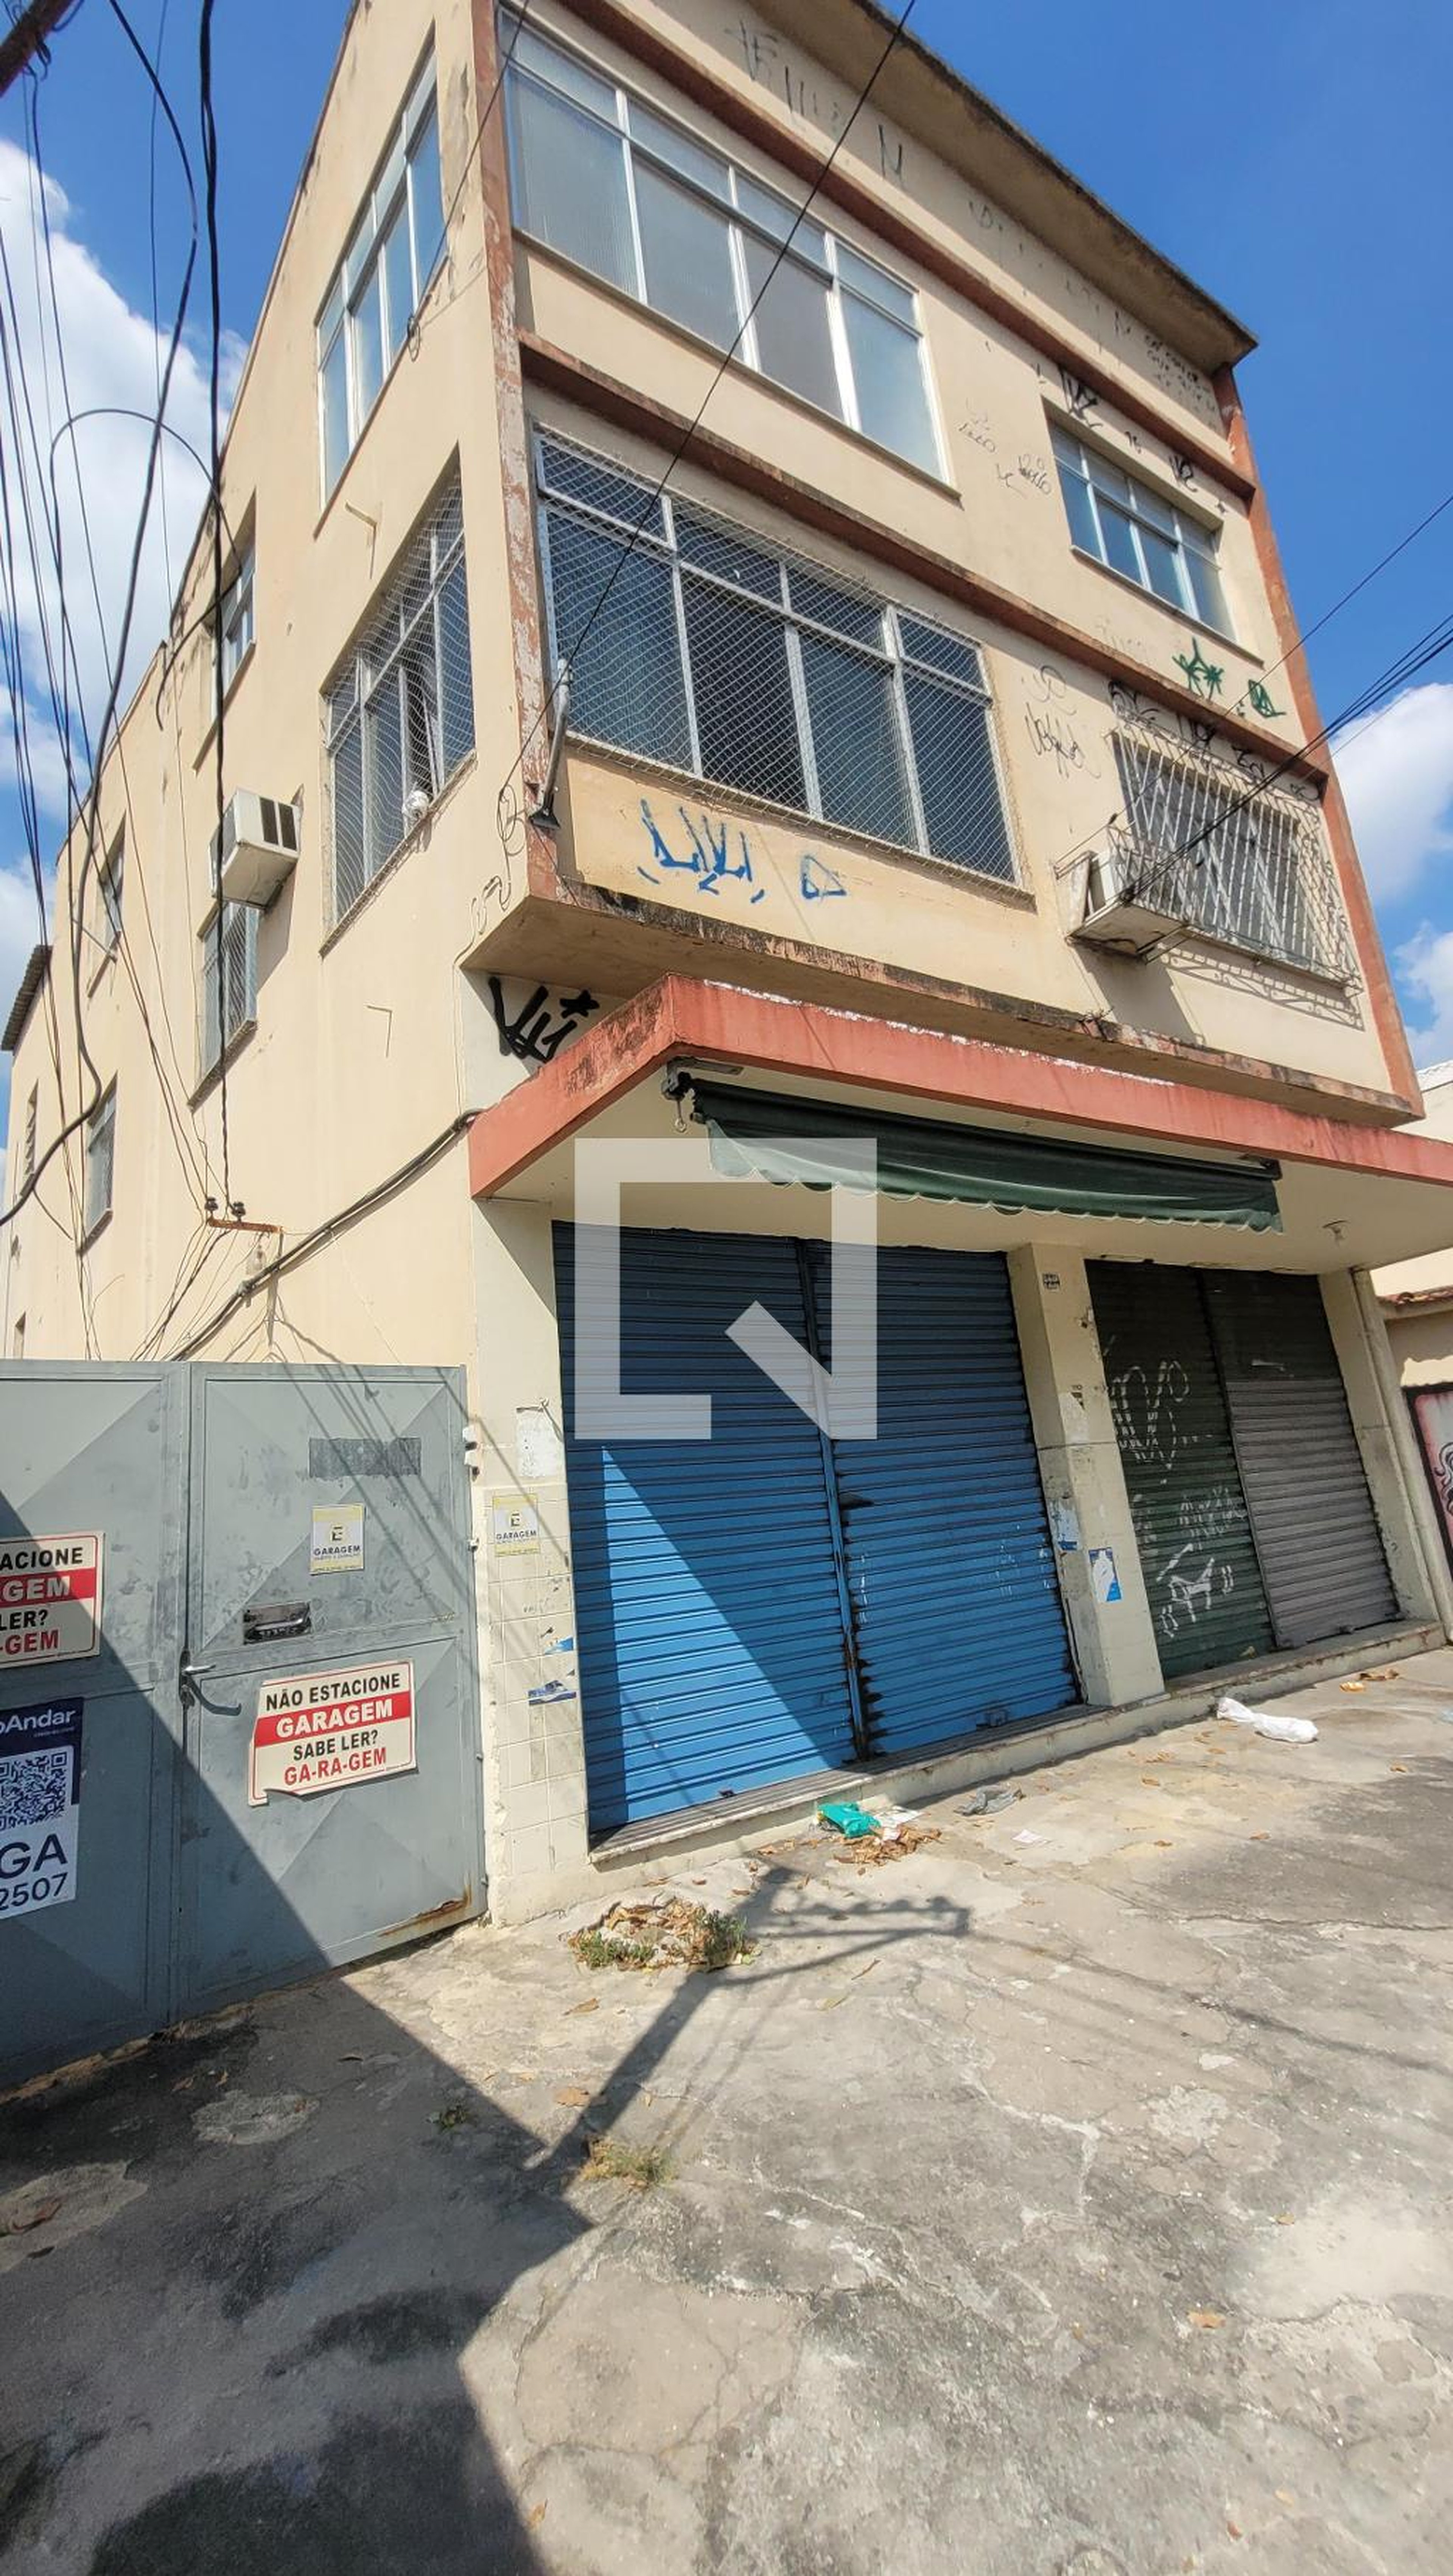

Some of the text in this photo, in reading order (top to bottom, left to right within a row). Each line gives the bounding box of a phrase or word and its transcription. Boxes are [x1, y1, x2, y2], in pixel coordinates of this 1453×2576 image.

[0, 1547, 83, 1570] ACIONE
[314, 1545, 360, 1556] GARAGEM
[0, 1609, 48, 1631] LER?
[266, 1673, 400, 1710] NÃO ESTACIONE
[276, 1698, 393, 1738] GARAGEM
[293, 1730, 378, 1760] SABE LER?
[285, 1747, 387, 1786] GA-RA-GEM
[0, 1833, 68, 1879] GA
